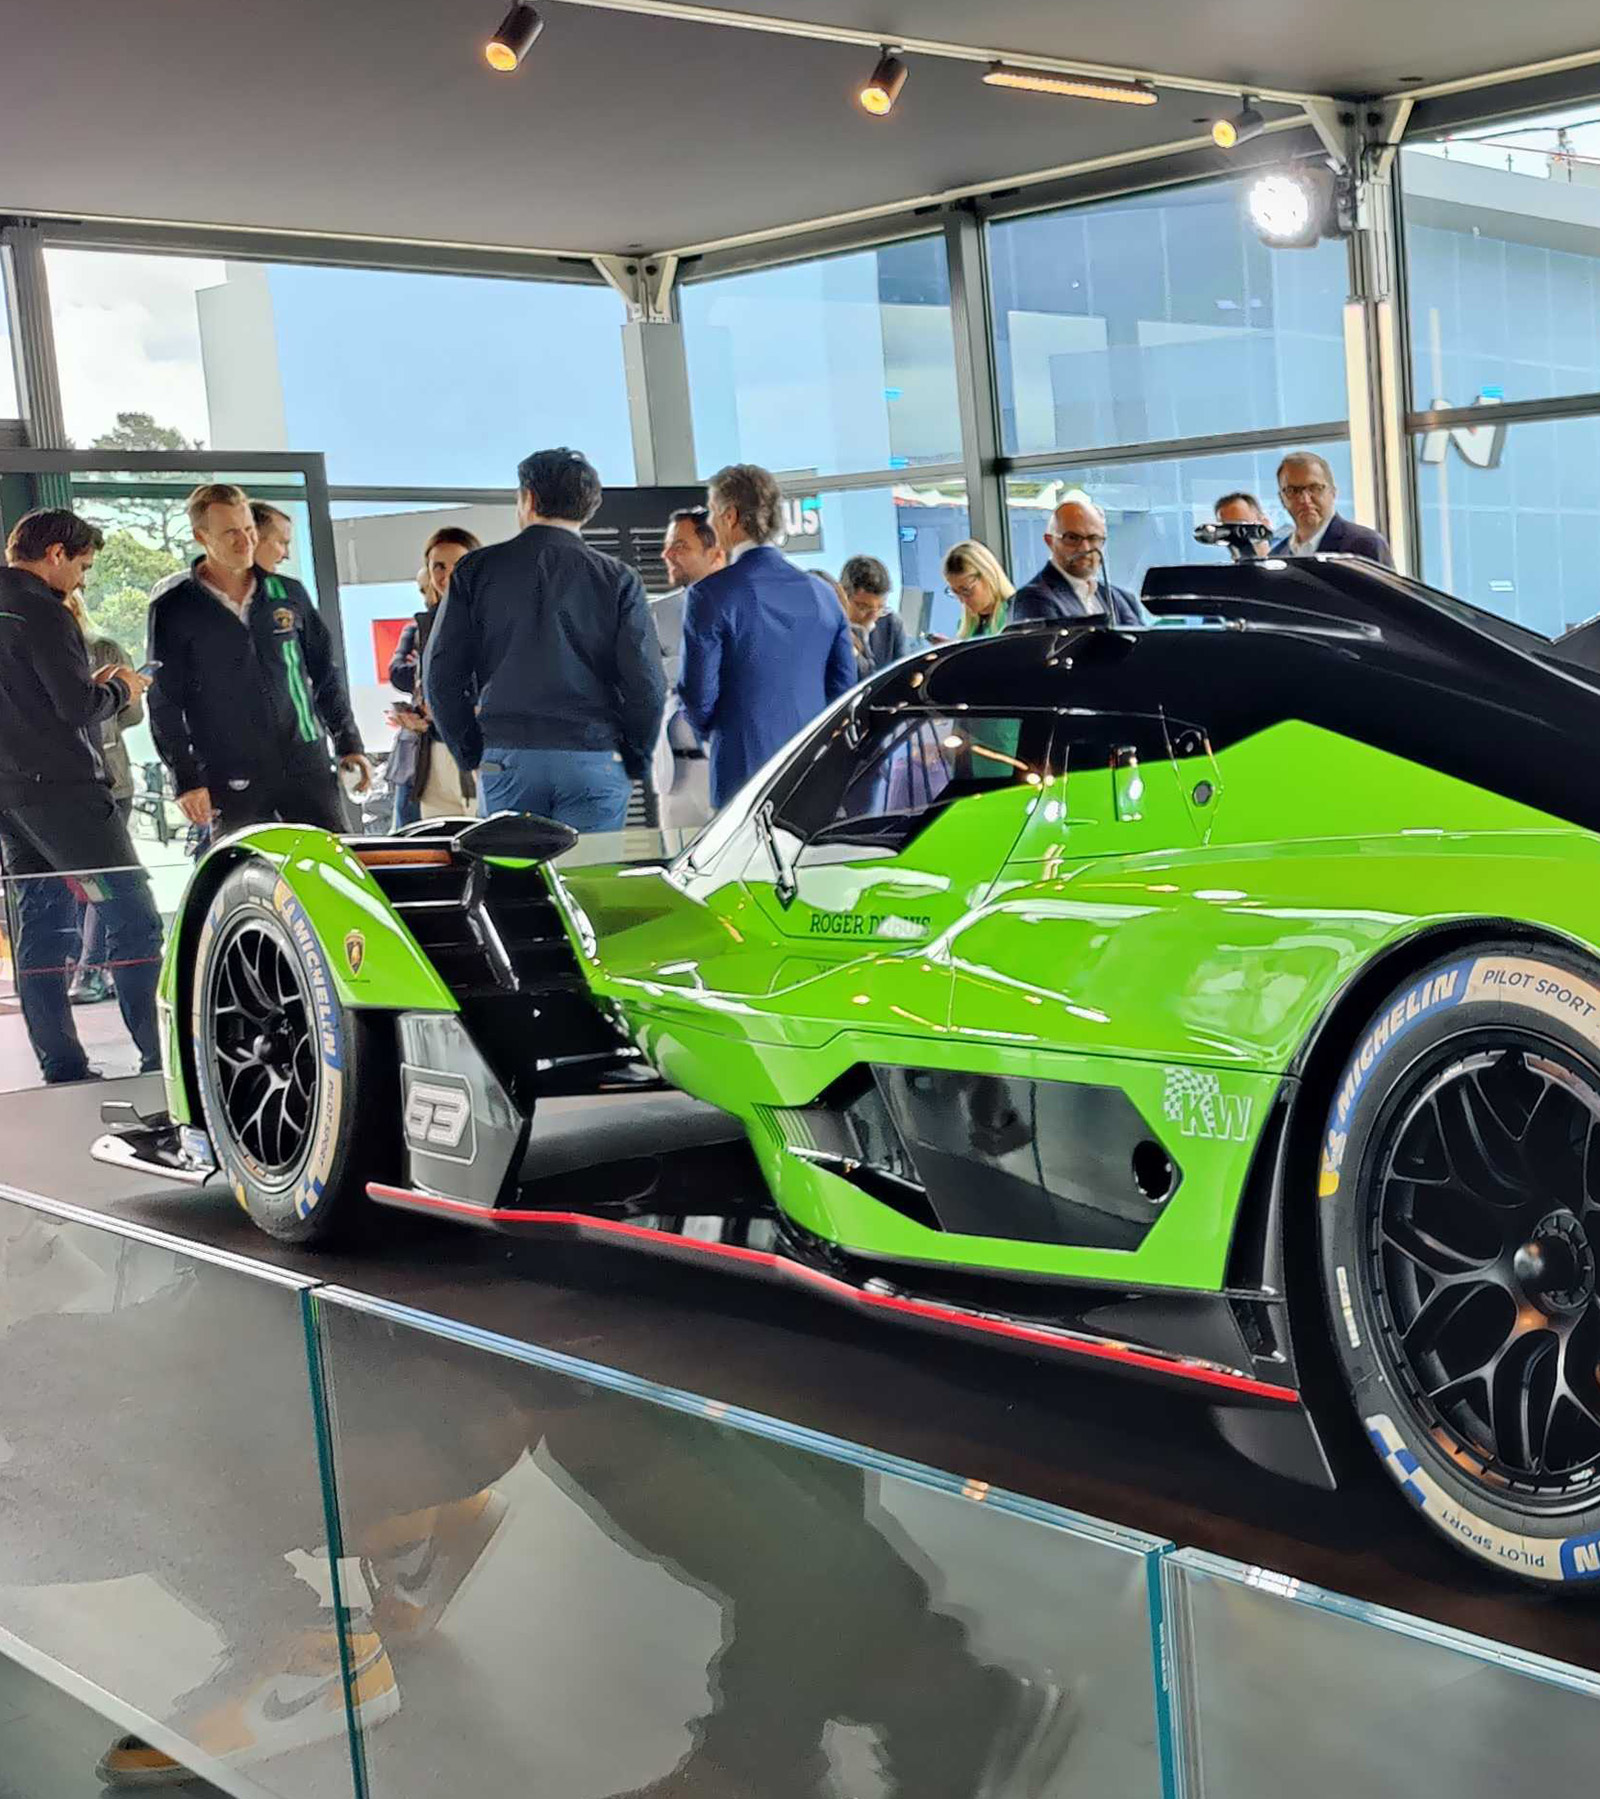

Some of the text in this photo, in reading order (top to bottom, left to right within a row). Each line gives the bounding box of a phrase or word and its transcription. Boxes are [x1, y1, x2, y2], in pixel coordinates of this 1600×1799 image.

[810, 913, 864, 935] ROGER
[293, 919, 336, 1057] MICHELIN
[1337, 970, 1597, 1123] MICHELIN PILOT SPORT
[405, 1081, 470, 1147] 63
[1181, 1092, 1253, 1142] KW
[1442, 1509, 1493, 1550] SPORT
[1499, 1549, 1545, 1568] PILOT
